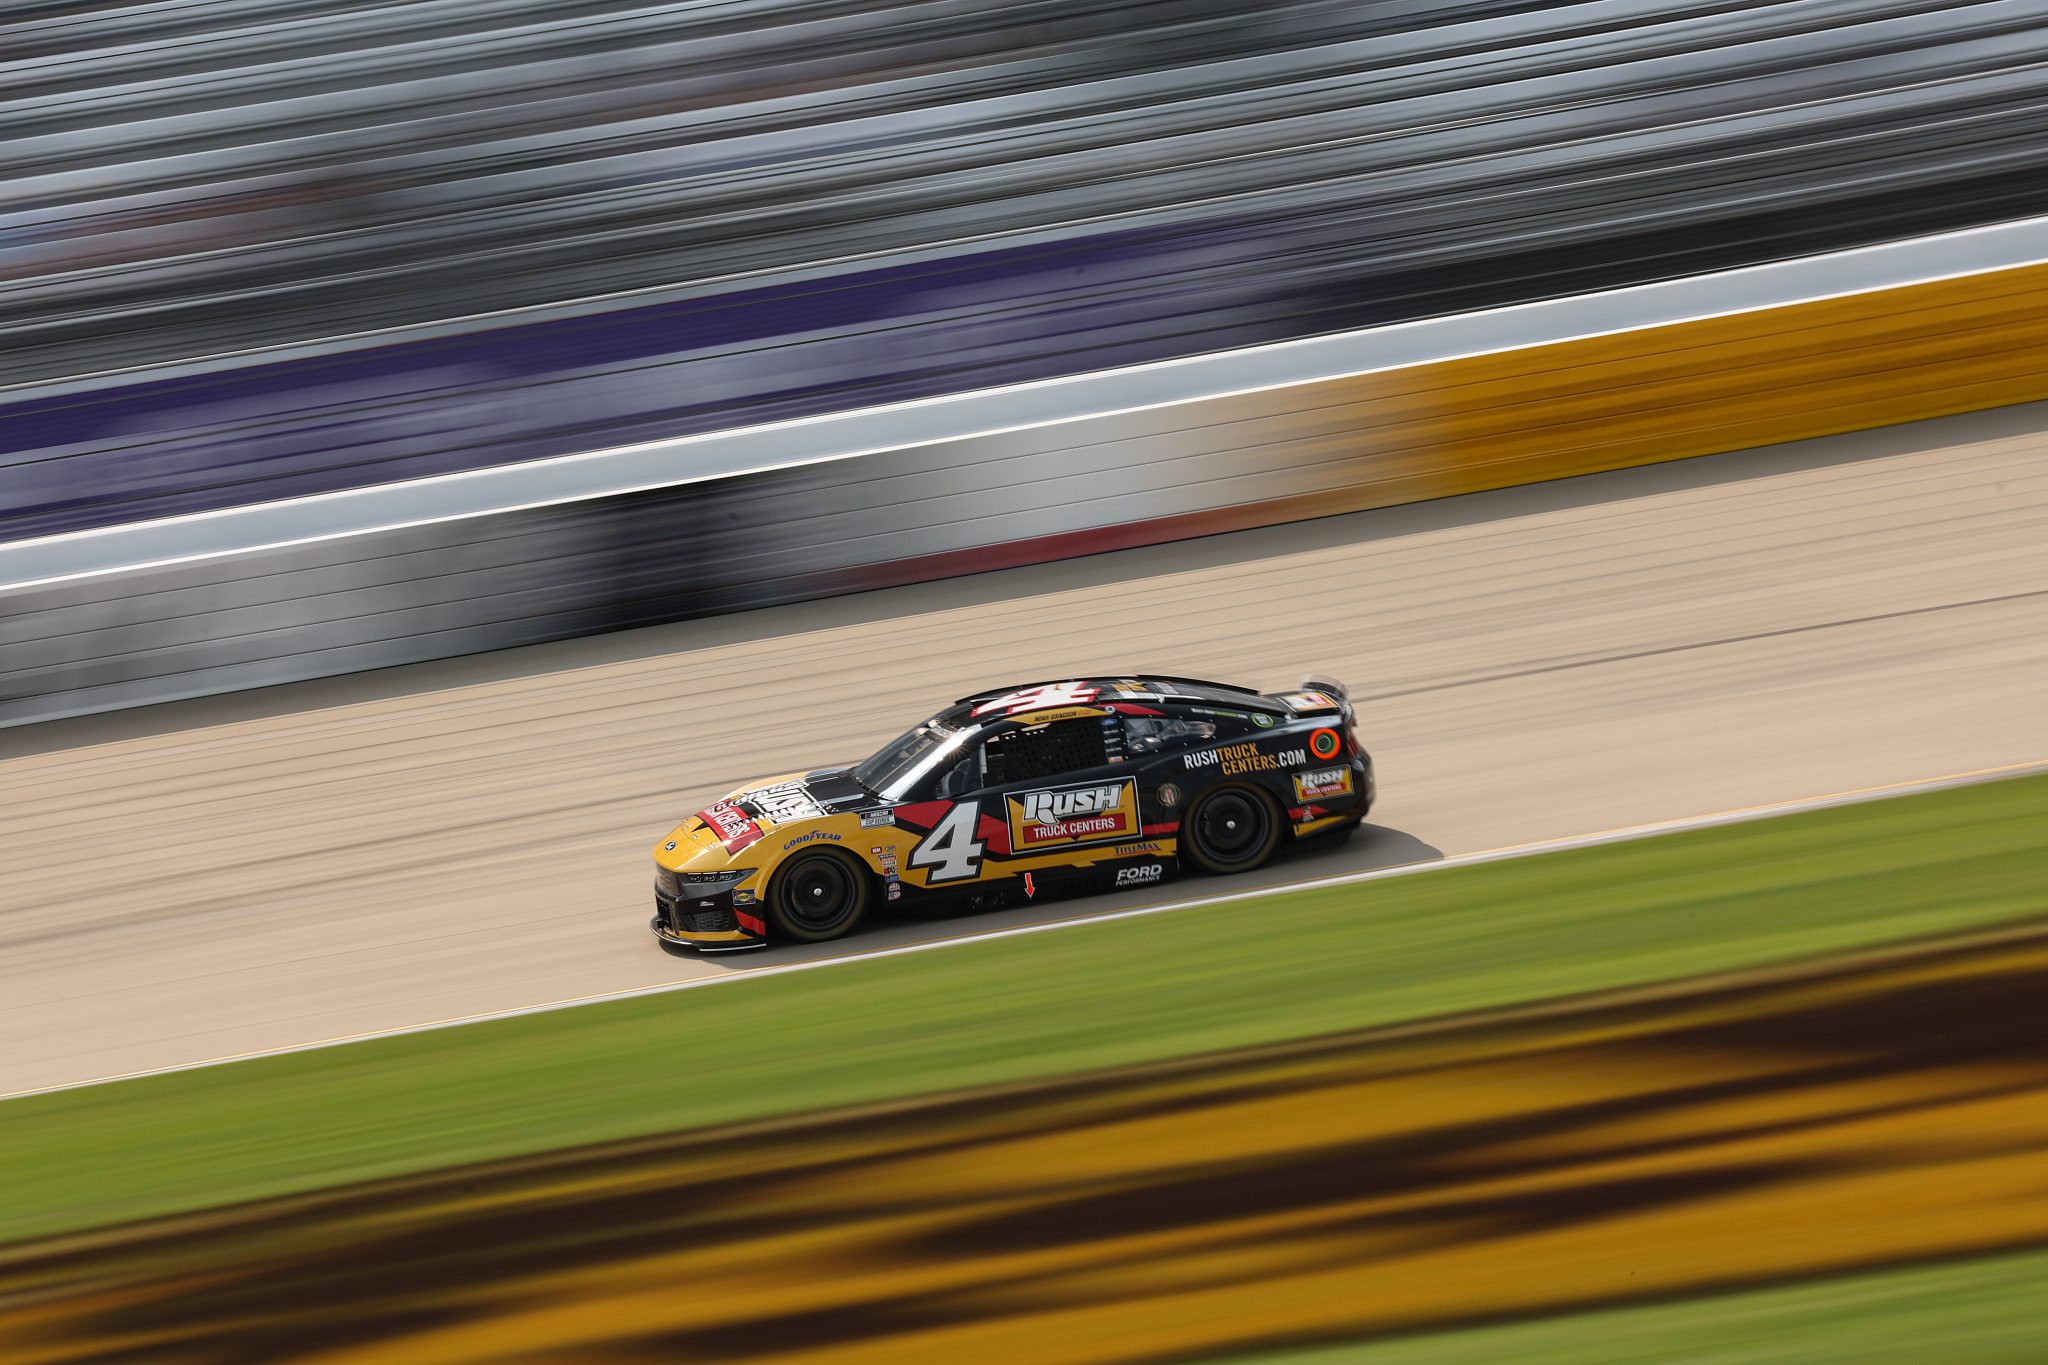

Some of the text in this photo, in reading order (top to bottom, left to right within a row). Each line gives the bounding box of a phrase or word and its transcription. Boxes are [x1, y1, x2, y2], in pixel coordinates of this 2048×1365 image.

[1301, 769, 1345, 789] RUSH
[1022, 784, 1122, 825] RUSH
[1034, 817, 1115, 838] TRUCK CENTERS
[783, 829, 842, 850] GOODYEAR
[908, 800, 984, 883] 4
[1115, 874, 1160, 887] PERFORMANCE
[1116, 864, 1162, 881] FORD
